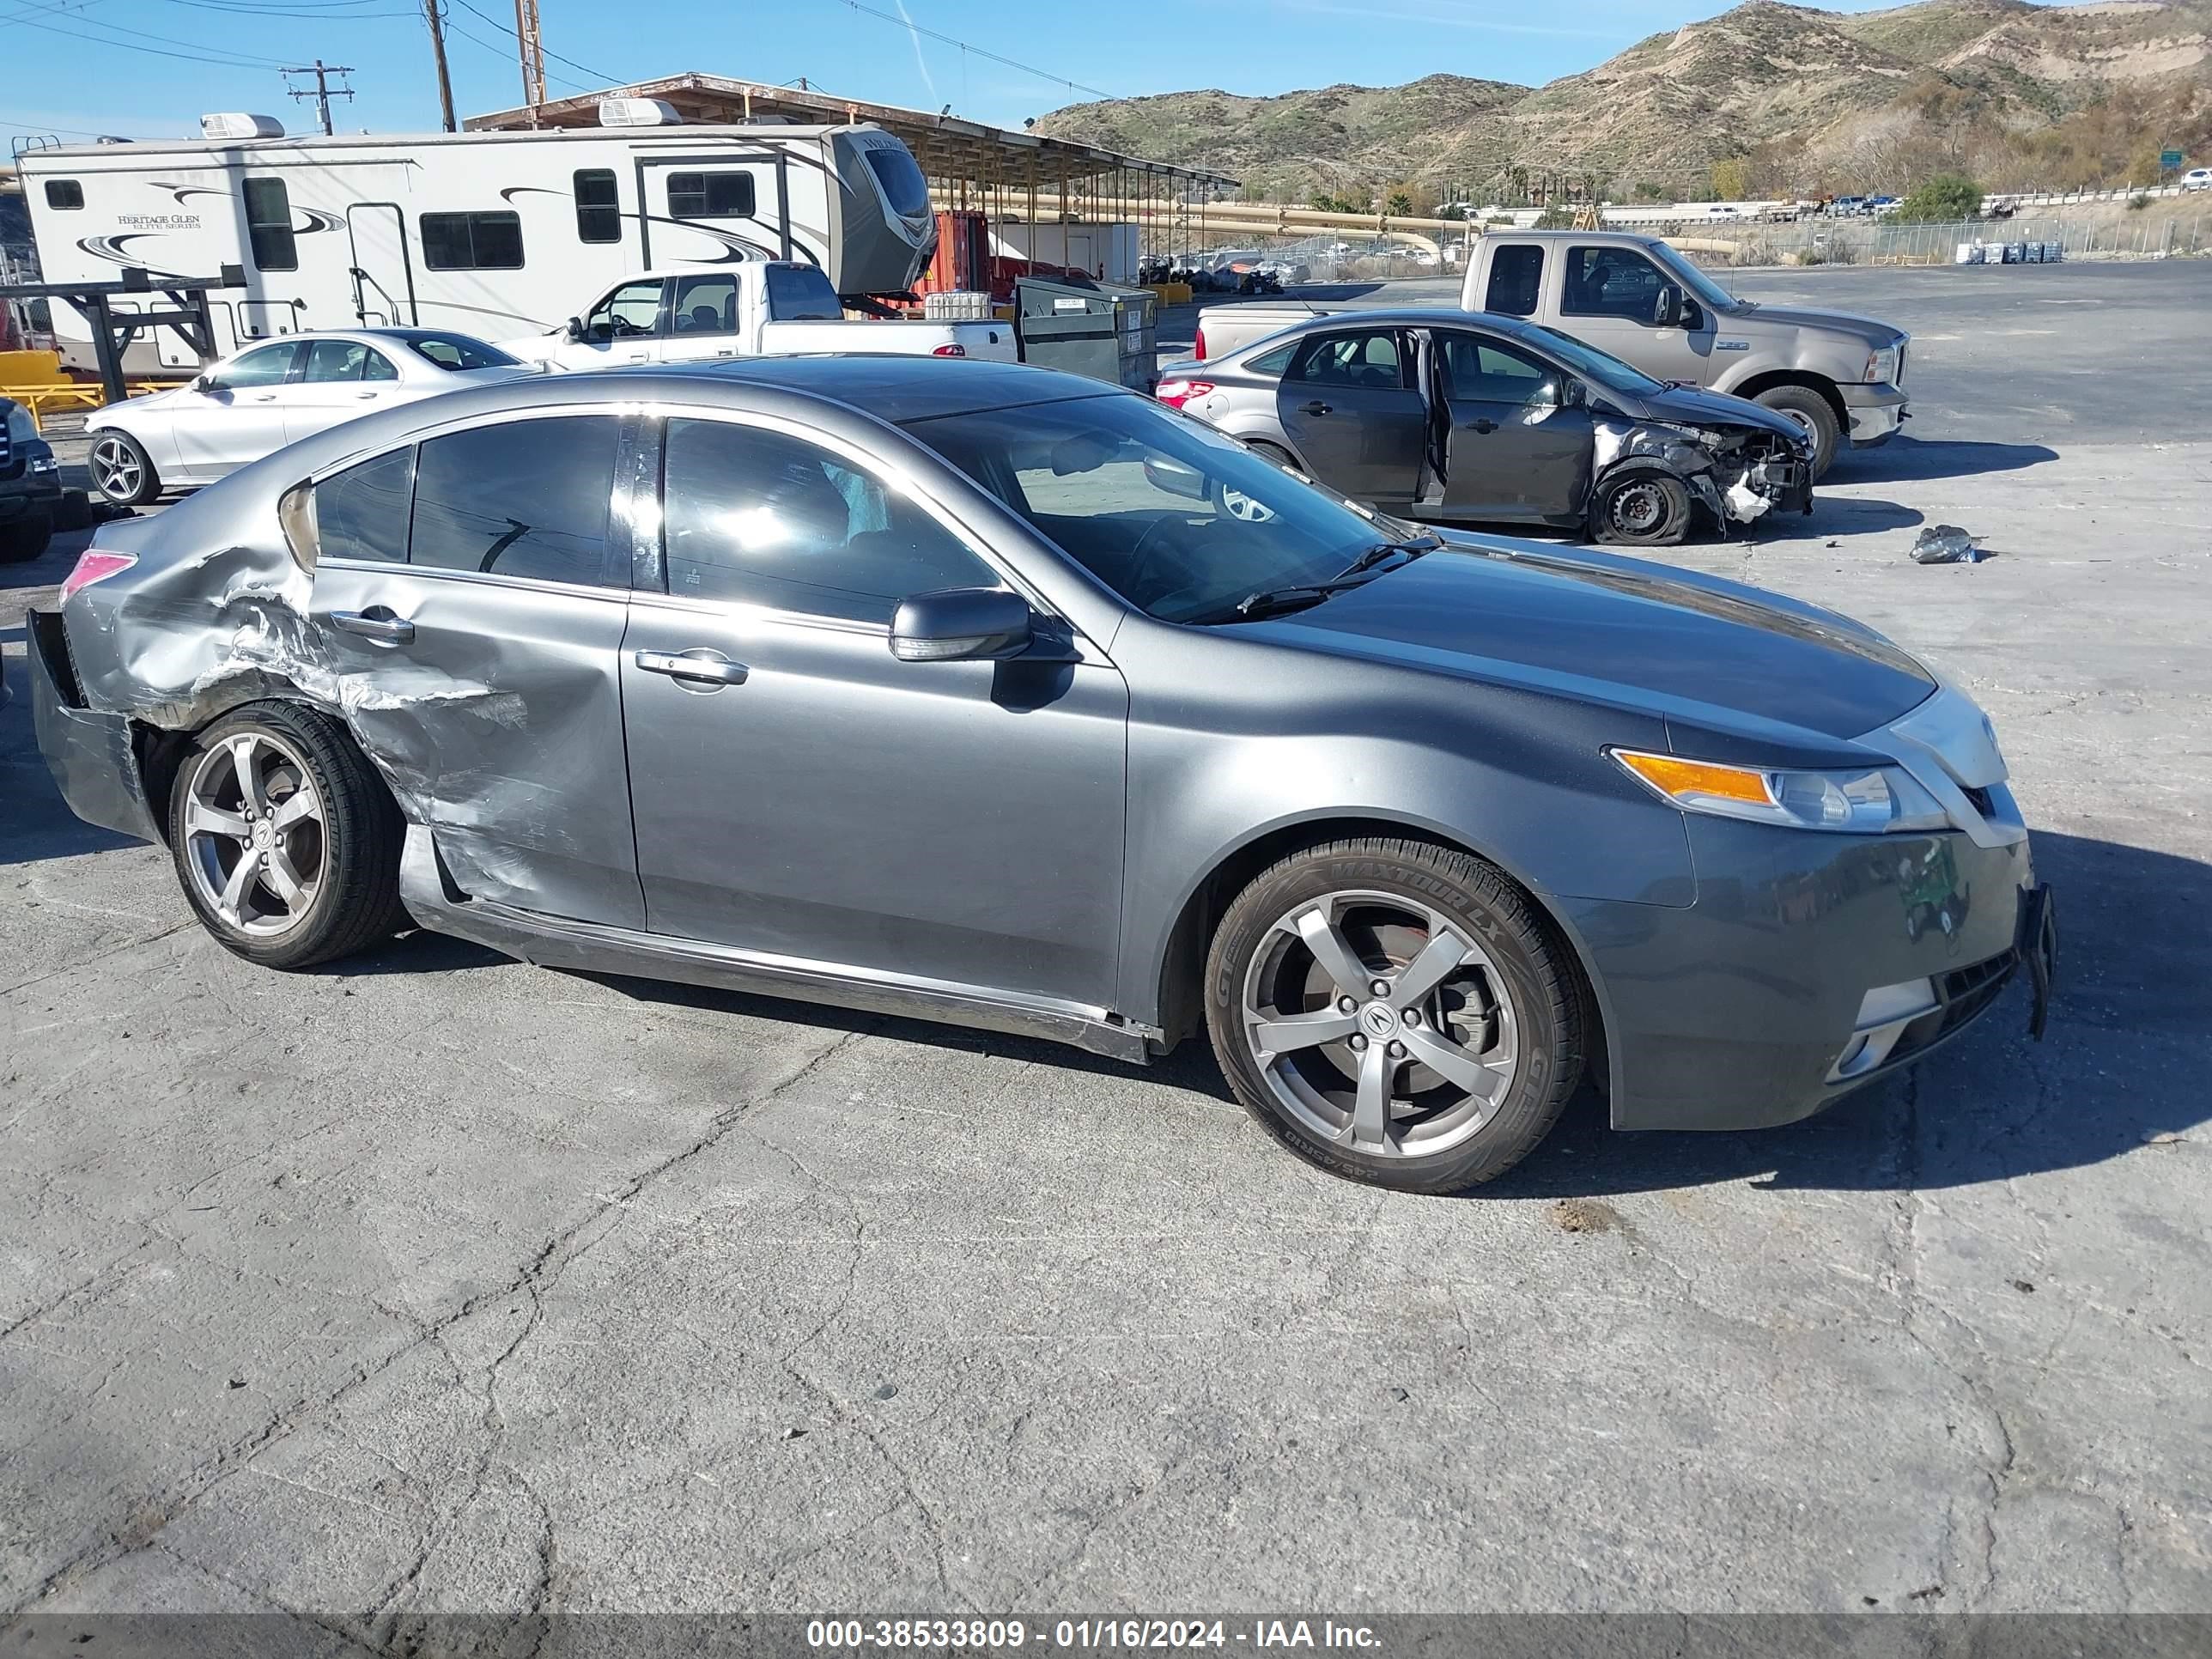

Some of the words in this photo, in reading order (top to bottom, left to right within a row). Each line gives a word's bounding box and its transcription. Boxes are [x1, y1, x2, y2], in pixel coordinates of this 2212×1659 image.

[117, 215, 169, 224] HERITAGE
[171, 214, 200, 223] GLEN
[1330, 861, 1468, 909] MAXTOUR
[1466, 907, 1505, 942] LX
